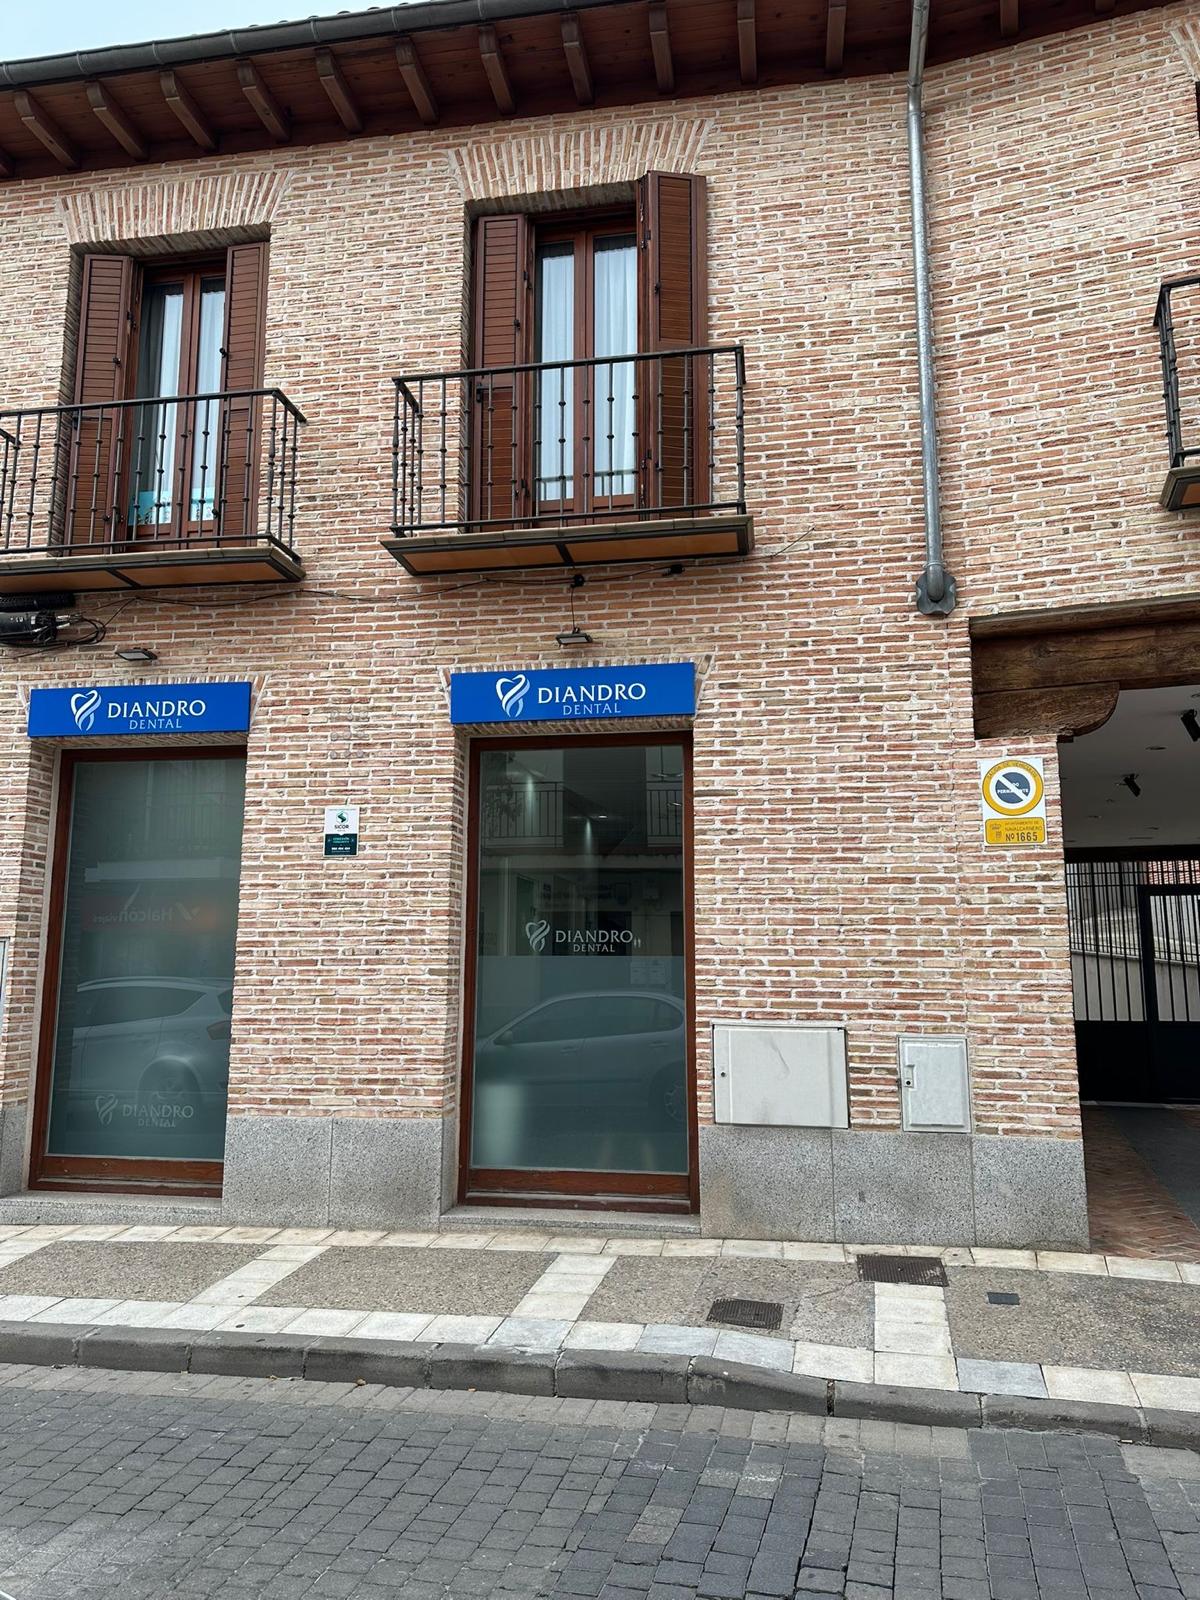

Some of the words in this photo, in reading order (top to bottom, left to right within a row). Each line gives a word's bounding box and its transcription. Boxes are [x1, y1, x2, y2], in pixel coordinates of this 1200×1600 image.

[538, 683, 646, 704] DIANDRO
[108, 700, 206, 718] DIANDRO
[563, 703, 621, 715] DENTAL
[129, 719, 182, 730] DENTAL
[1016, 832, 1038, 842] 1665
[555, 930, 633, 943] DIANDRO
[573, 944, 615, 953] DENTAL
[122, 1104, 194, 1118] DIANDRO
[138, 1118, 176, 1128] DENTAL
